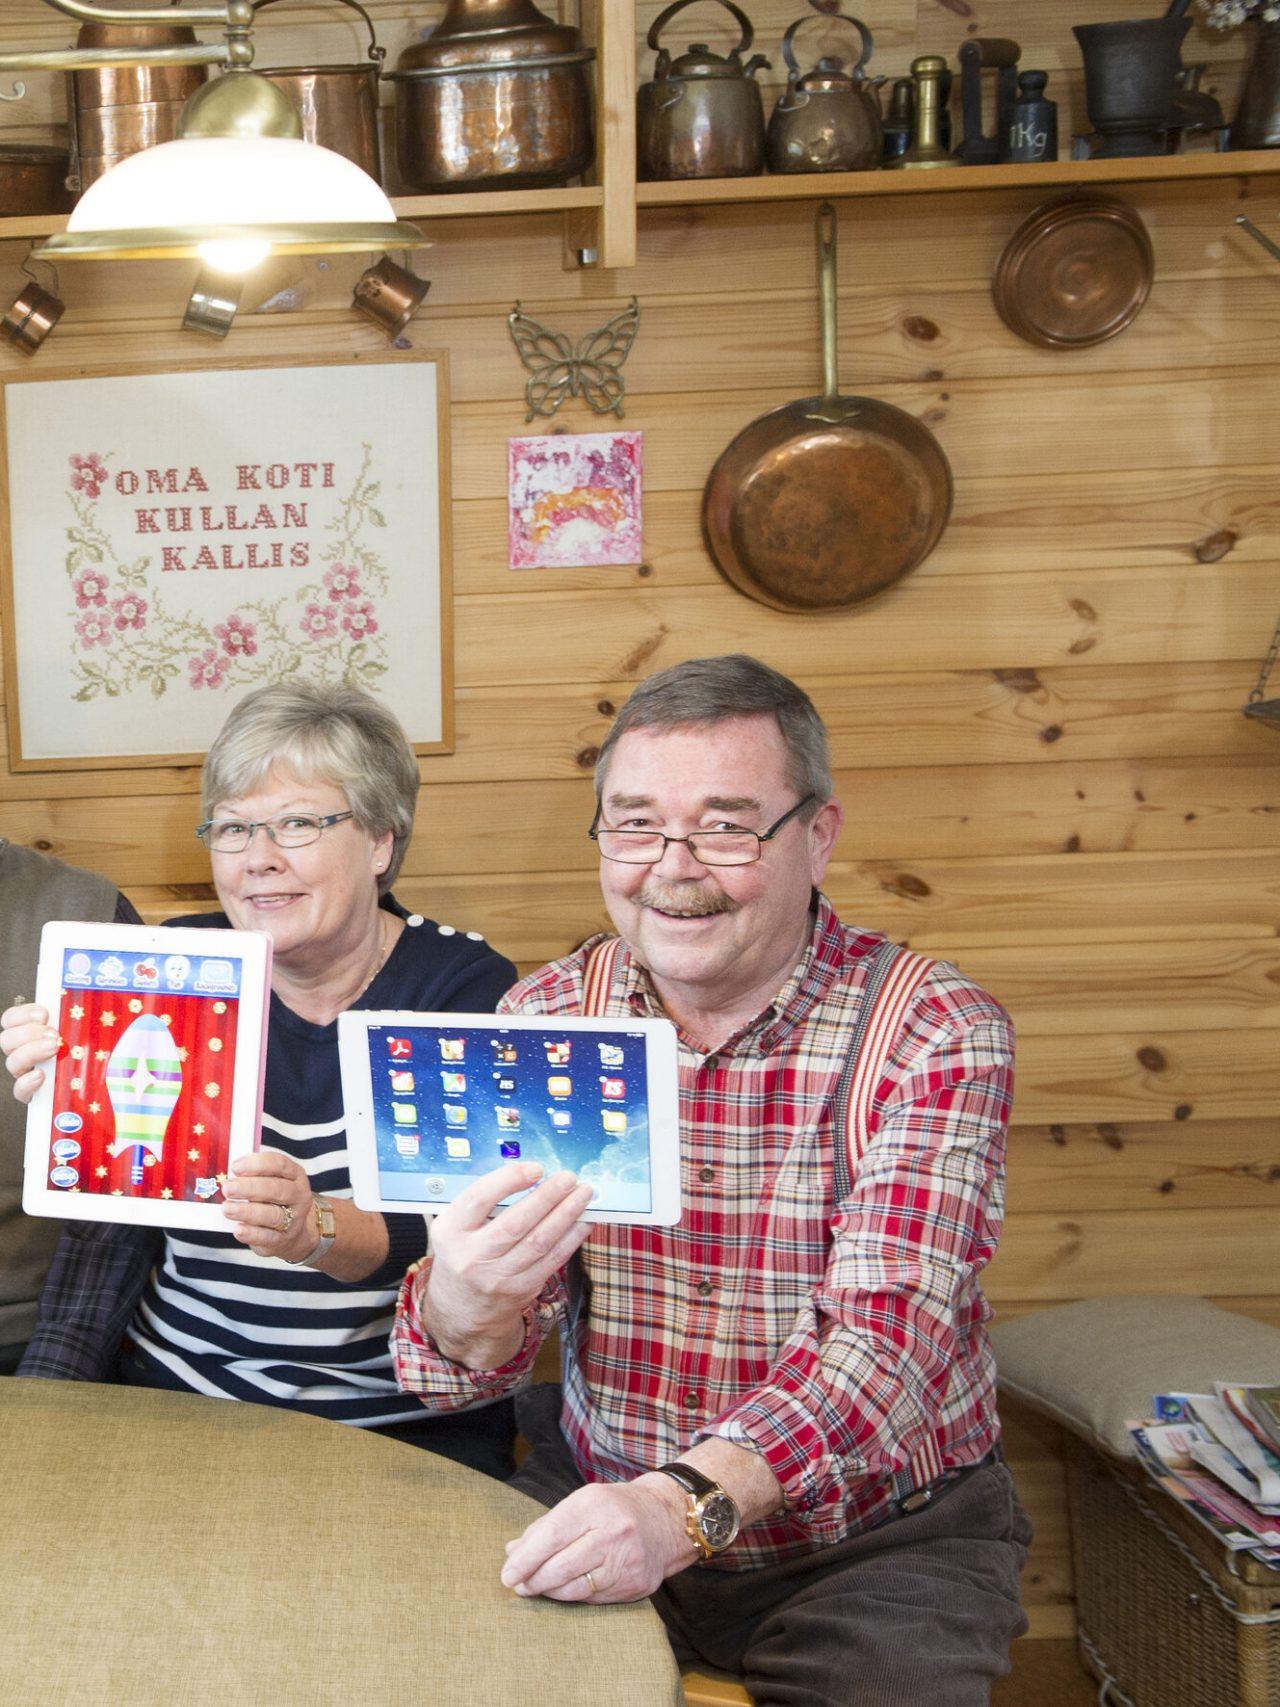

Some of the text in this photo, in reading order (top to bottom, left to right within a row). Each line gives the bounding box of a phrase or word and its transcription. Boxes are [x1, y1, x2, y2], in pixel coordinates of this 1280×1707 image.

[114, 462, 336, 496] OMA KOTI
[135, 502, 308, 534] KULLAN
[161, 542, 310, 572] KALLIS
